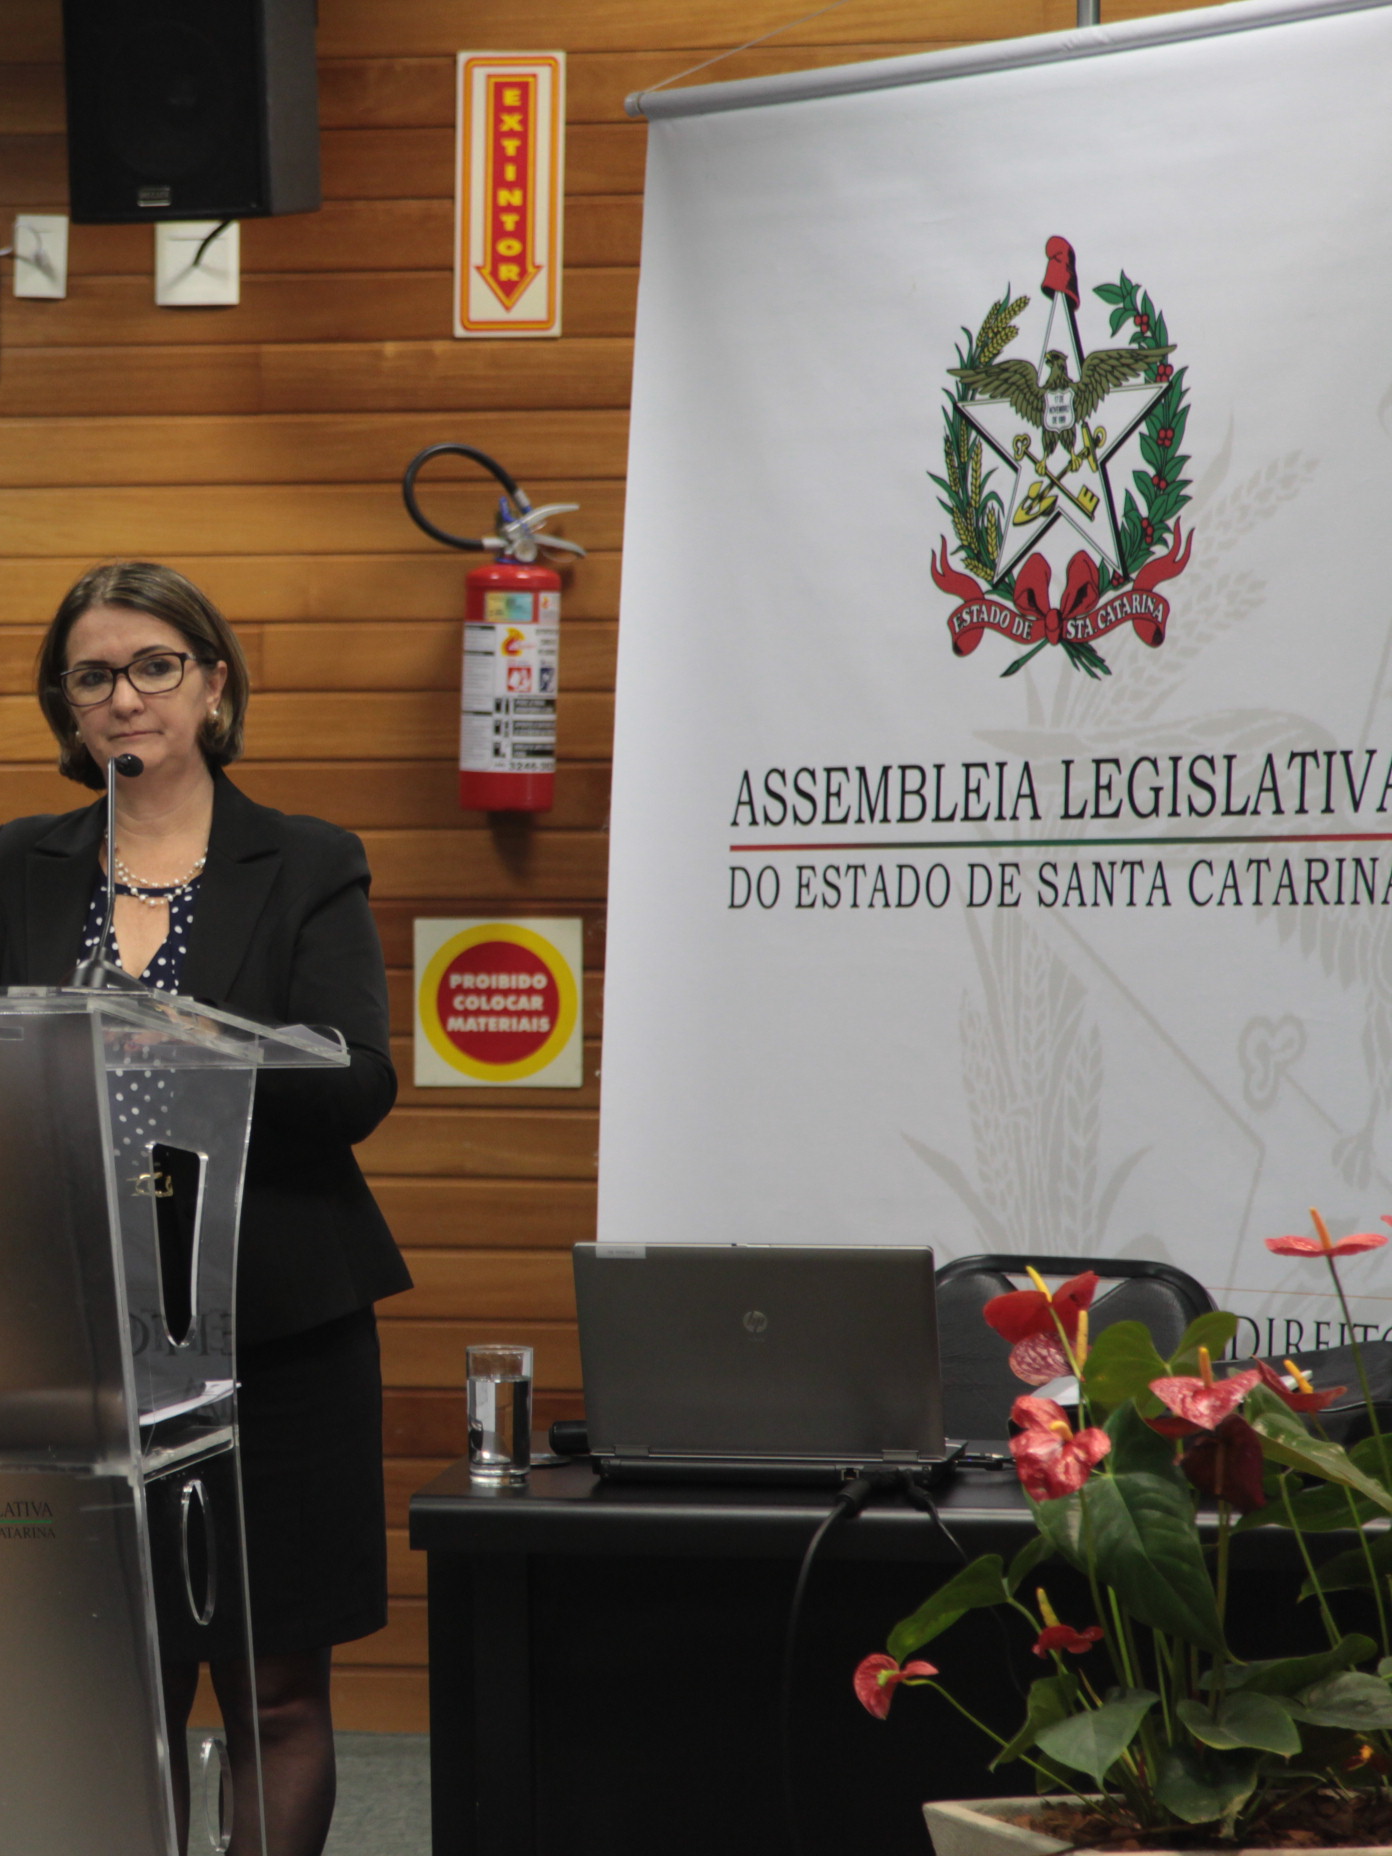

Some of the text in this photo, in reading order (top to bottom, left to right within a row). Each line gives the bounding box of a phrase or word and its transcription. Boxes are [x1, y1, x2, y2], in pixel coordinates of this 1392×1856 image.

[496, 87, 523, 282] EXTINTOR
[953, 594, 1164, 640] ESTADO DE STA. CATARINA
[730, 760, 1042, 826] ASSEMBLEIA
[728, 865, 780, 909] DO
[795, 863, 951, 909] ESTADO
[966, 862, 1021, 908] DE
[1038, 860, 1172, 908] SANTA
[449, 973, 548, 990] PROIBIDO
[452, 995, 544, 1011] COLOCAR
[446, 1016, 551, 1033] MATERIAIS
